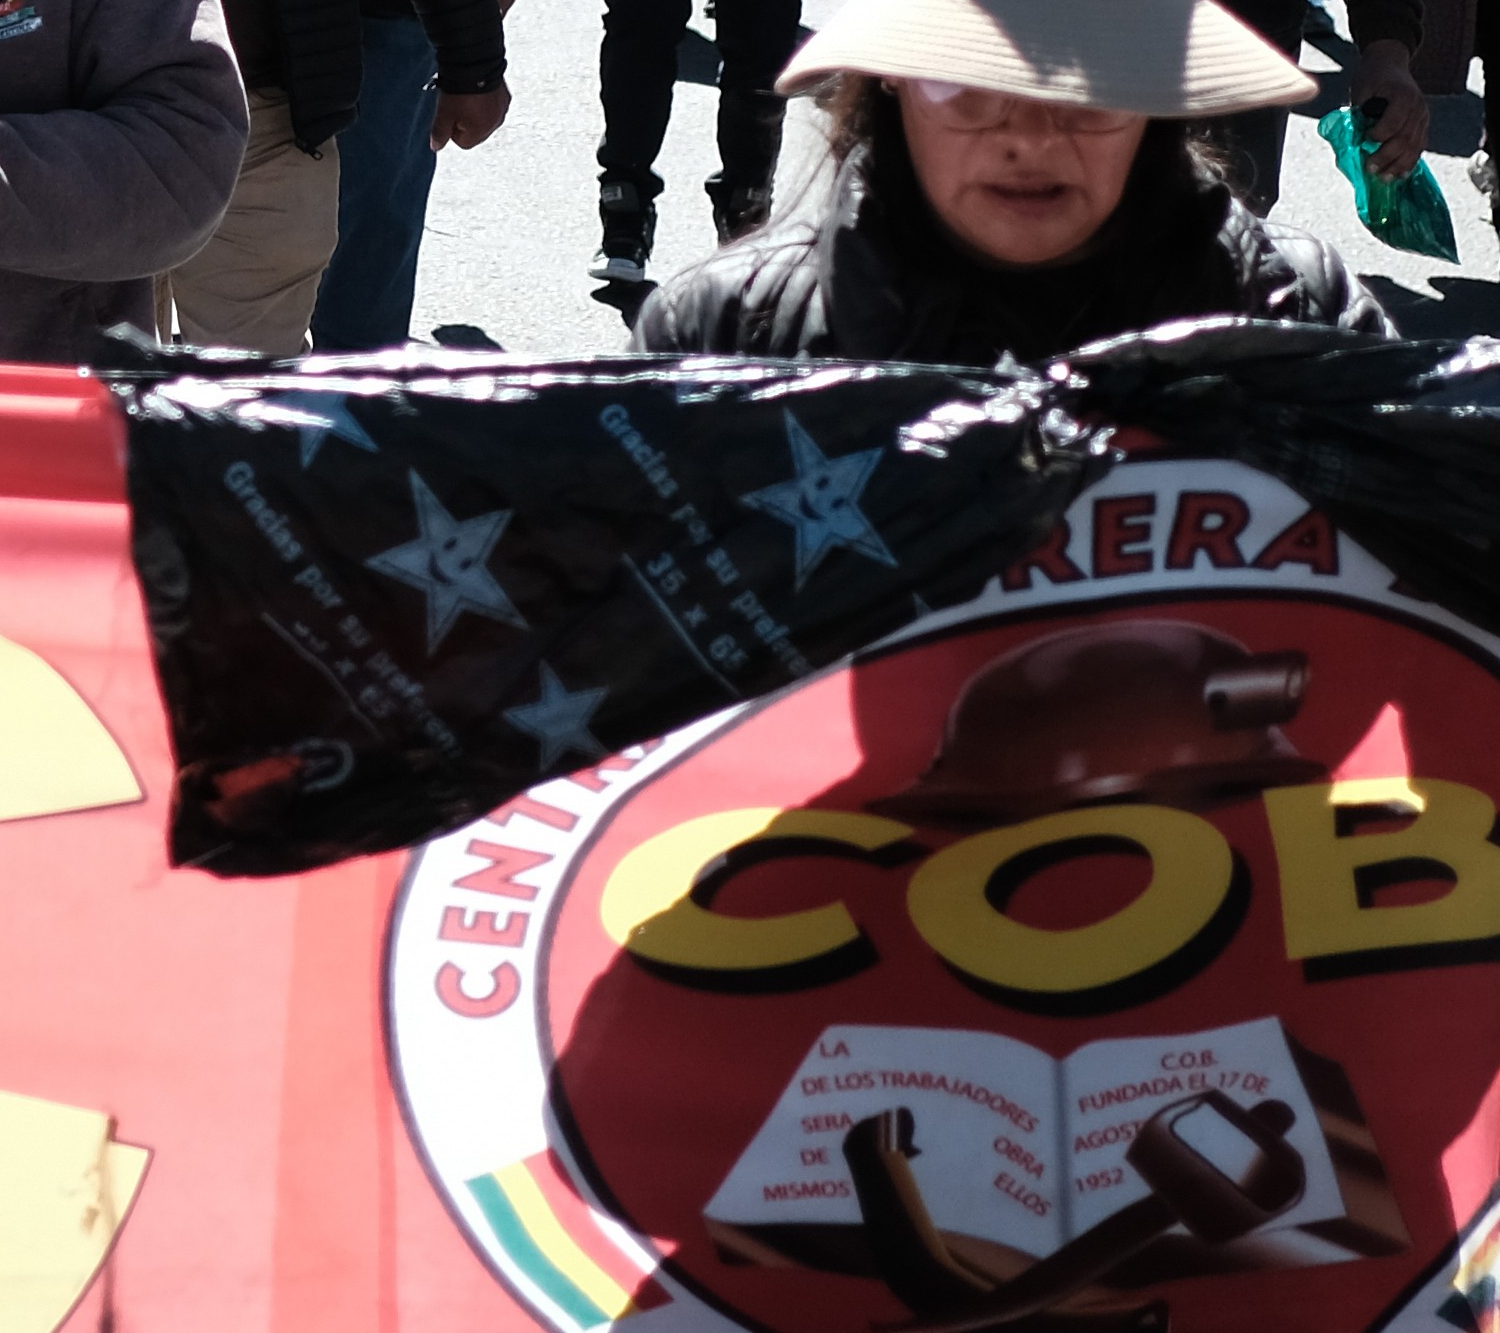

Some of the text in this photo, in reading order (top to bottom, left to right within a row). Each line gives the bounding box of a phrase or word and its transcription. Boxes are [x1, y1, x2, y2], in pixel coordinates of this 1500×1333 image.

[600, 402, 679, 501] Gracias
[705, 545, 741, 589] su
[223, 461, 305, 564] Gracias
[294, 566, 344, 610] por
[337, 613, 369, 650] su
[644, 551, 688, 598] 35
[680, 605, 708, 630] x
[819, 1039, 850, 1059] LA
[1160, 1048, 1219, 1071] C.O.B.
[801, 1068, 1040, 1134] DE LOS TRABAJADORES
[1077, 1071, 1271, 1116] FUNDADA EL 17 DE
[801, 1110, 1048, 1180] SERA OBRA
[761, 1179, 852, 1203] MISMOS
[800, 1146, 1051, 1218] DE ELLOS
[1074, 1166, 1127, 1194] 1952
